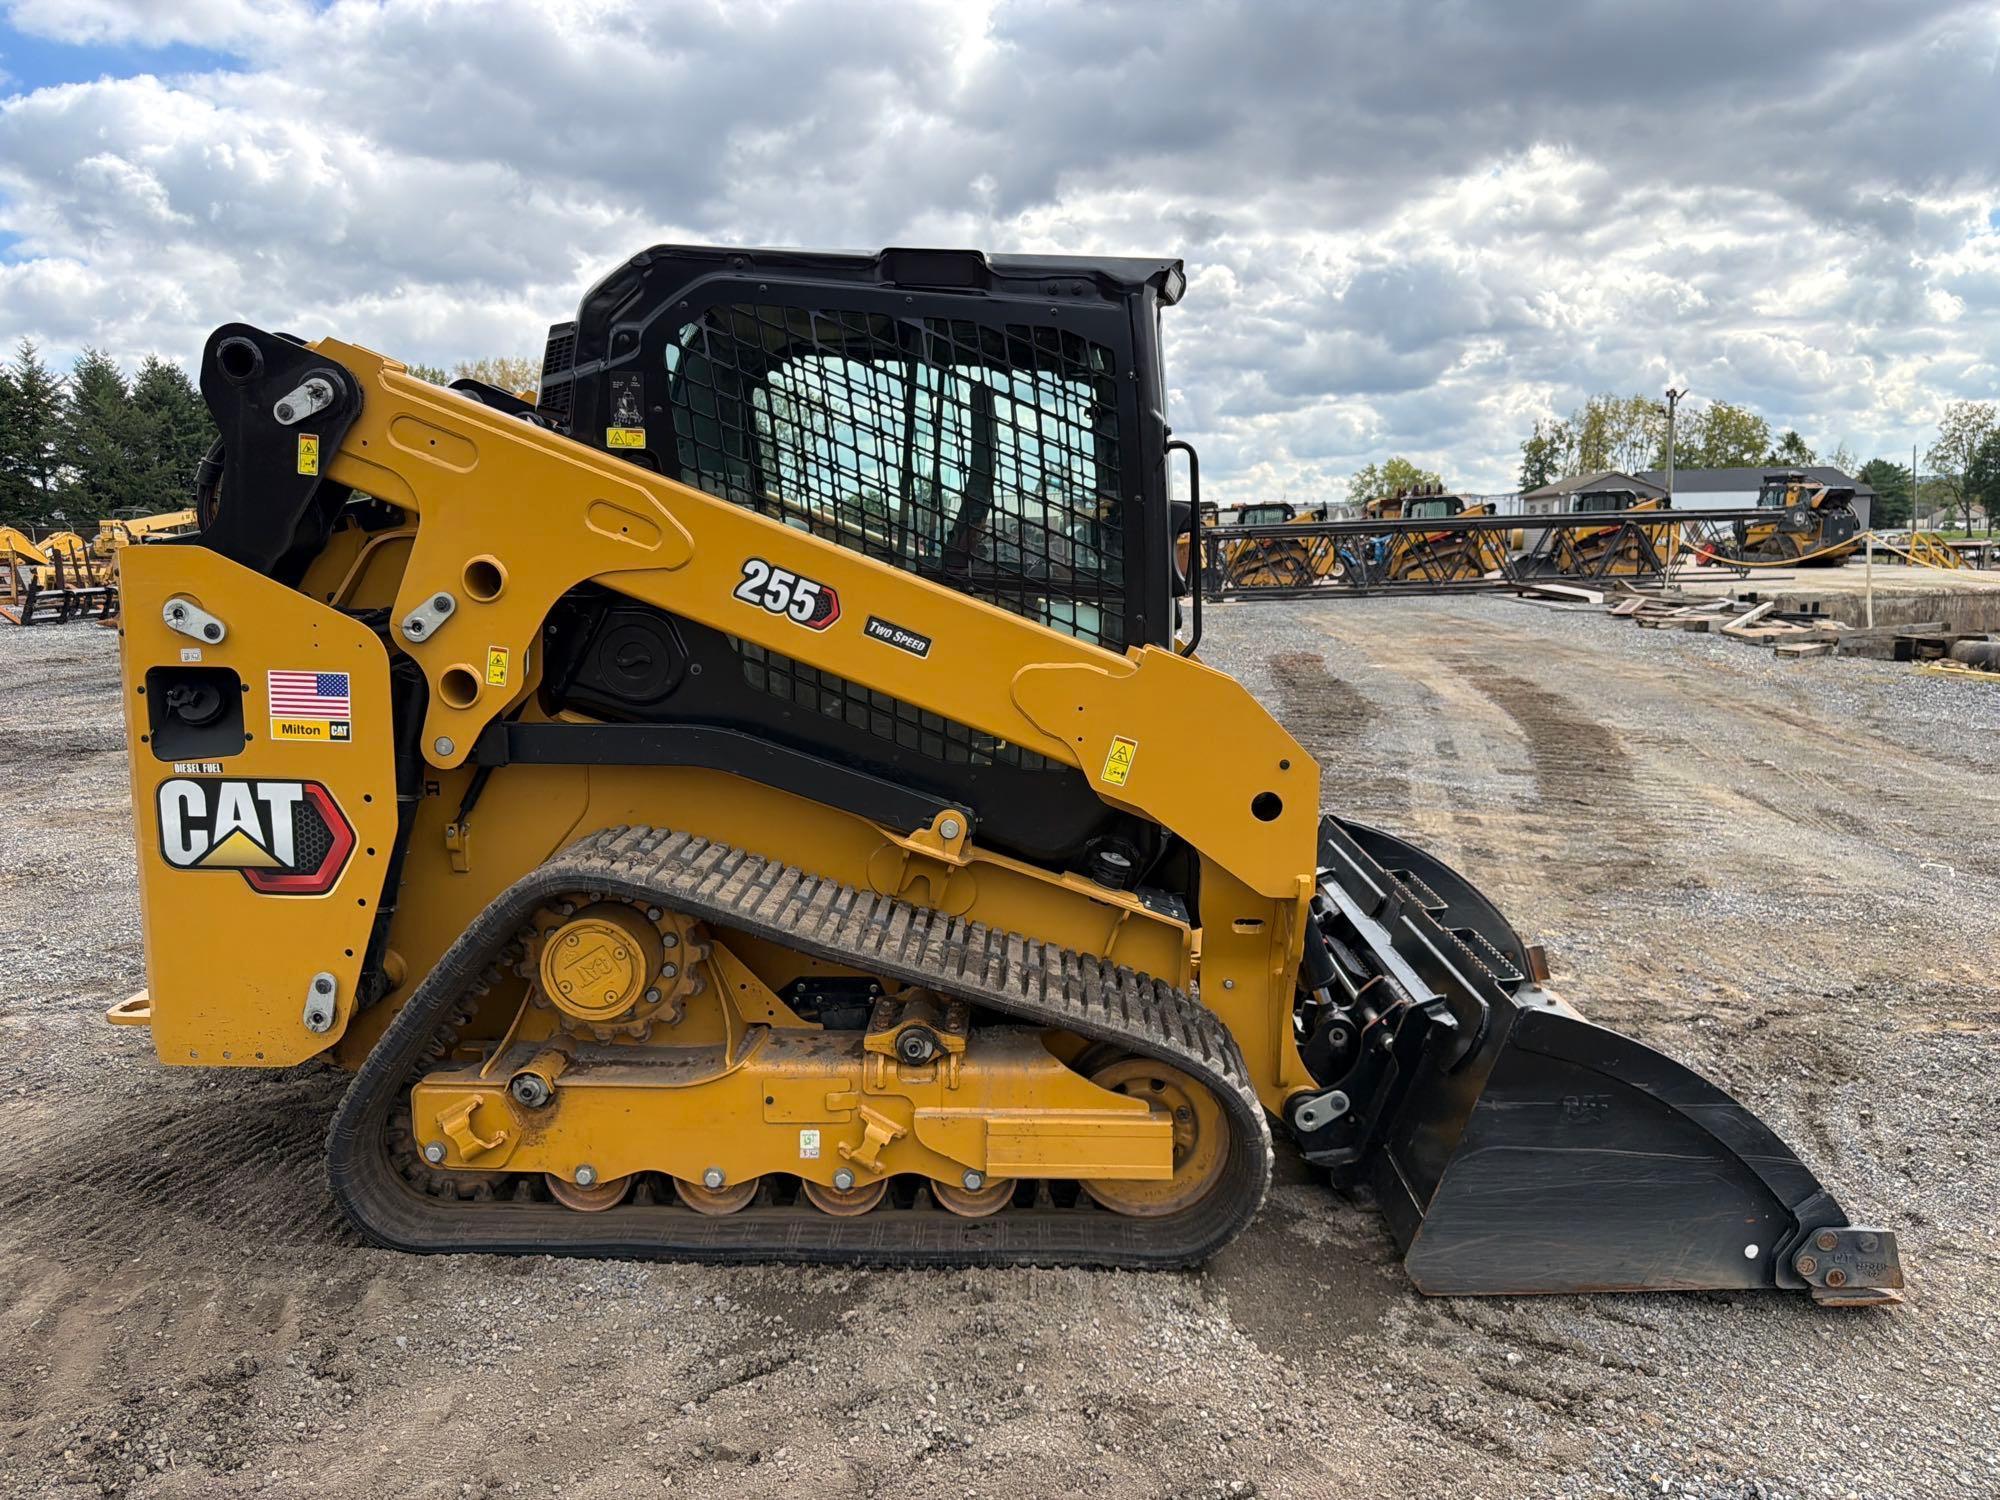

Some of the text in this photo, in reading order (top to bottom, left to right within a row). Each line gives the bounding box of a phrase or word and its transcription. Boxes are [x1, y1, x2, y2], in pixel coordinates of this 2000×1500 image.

[736, 559, 821, 621] 255
[282, 724, 348, 737] Milton CAT
[174, 763, 221, 773] DIESEL FUEL
[160, 780, 304, 866] CAT
